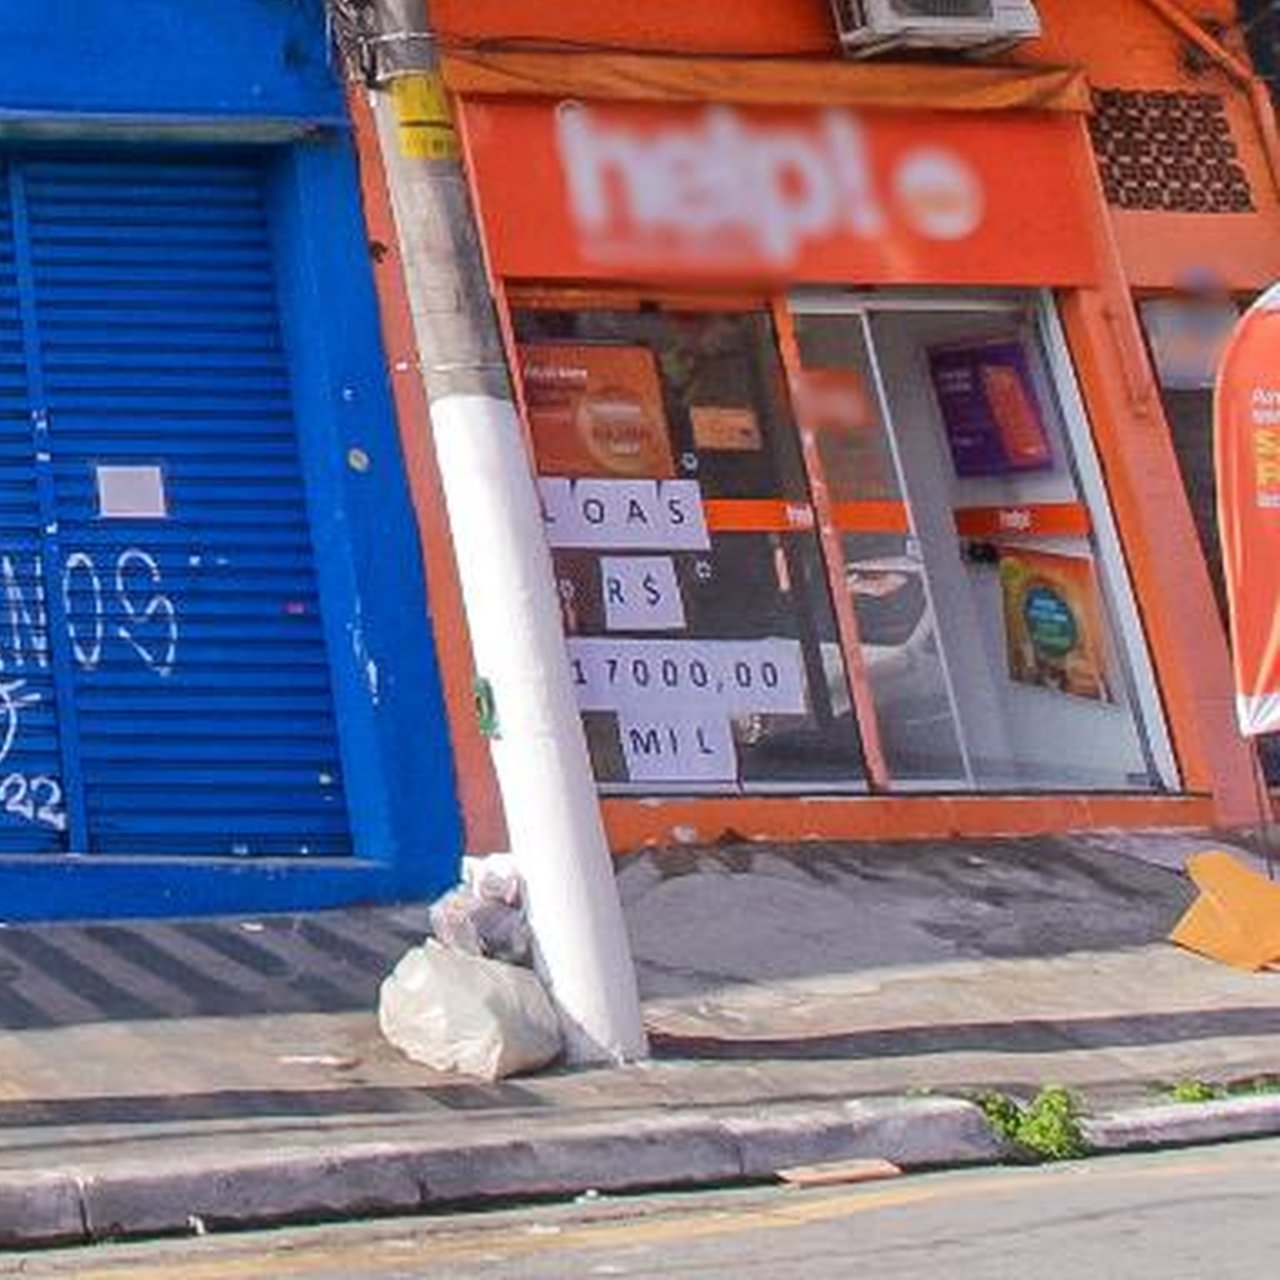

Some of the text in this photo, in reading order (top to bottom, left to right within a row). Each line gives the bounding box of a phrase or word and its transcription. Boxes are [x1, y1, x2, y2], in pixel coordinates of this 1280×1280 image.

[606, 574, 662, 606] R$
[571, 658, 779, 694] 17000,00
[629, 727, 716, 756] MIL
